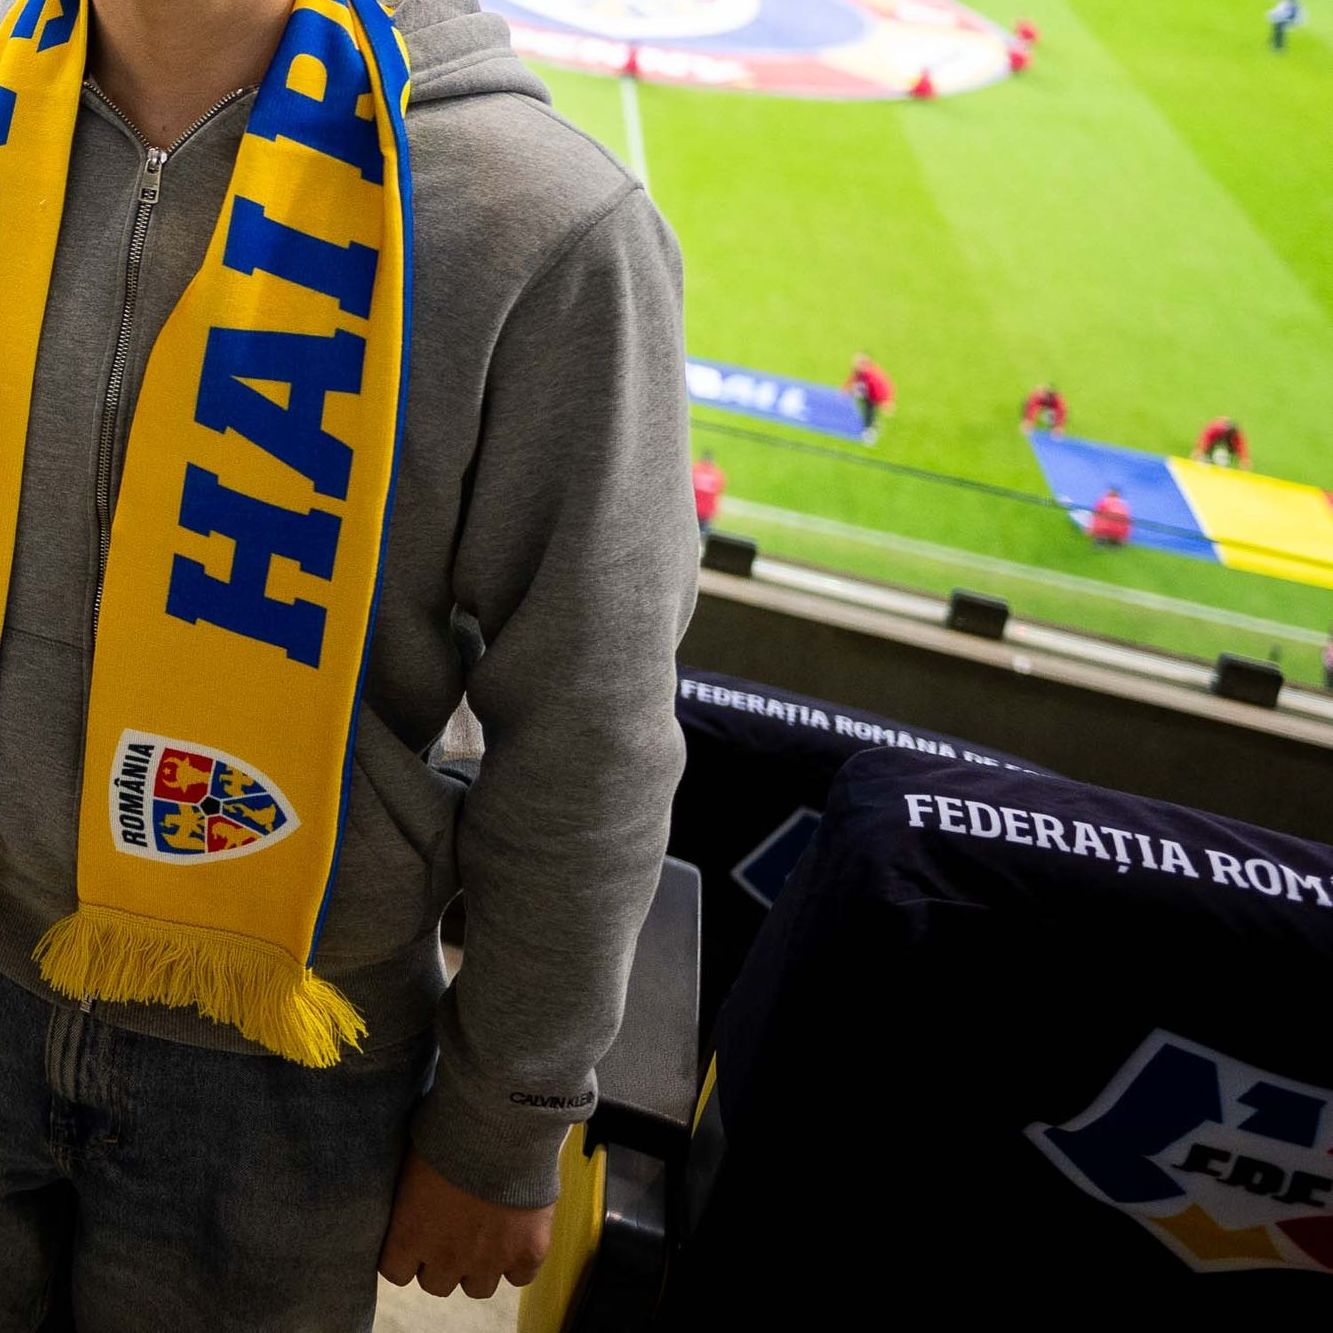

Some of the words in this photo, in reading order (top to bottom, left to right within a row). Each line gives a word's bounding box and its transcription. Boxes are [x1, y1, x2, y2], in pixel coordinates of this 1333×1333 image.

[165, 195, 381, 669] HAI
[114, 743, 155, 848] ROMÂNIA
[903, 793, 1199, 878] FEDERAȚIA
[1204, 848, 1333, 907] ROM
[509, 1092, 565, 1108] CALVIN
